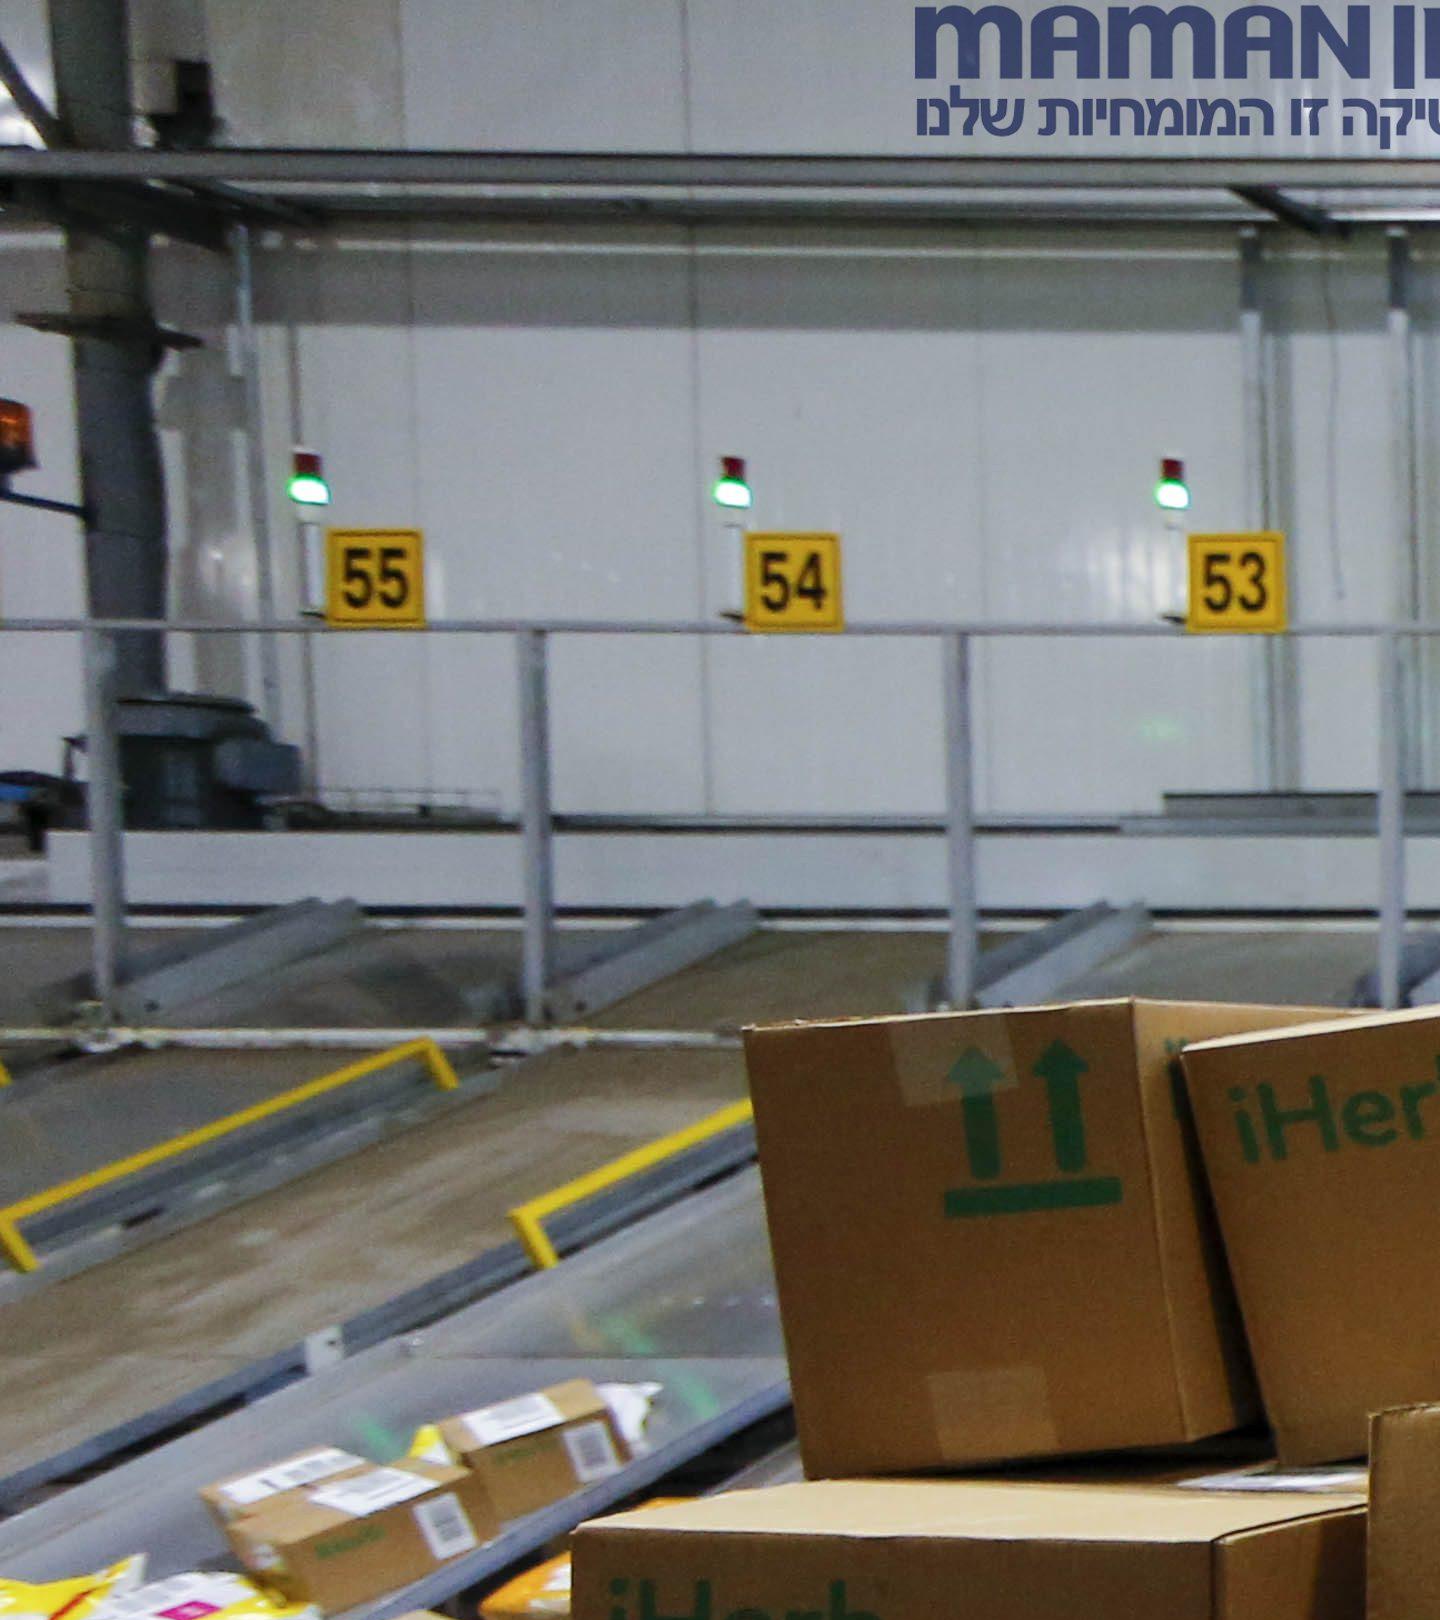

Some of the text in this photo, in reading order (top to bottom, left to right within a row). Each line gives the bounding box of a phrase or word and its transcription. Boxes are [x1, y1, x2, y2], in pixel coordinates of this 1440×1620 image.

[914, 5, 1370, 79] MAMAN
[915, 86, 1025, 137] שלנו
[1038, 97, 1274, 136] המומחיות
[1289, 98, 1329, 136] זו
[343, 547, 410, 610] 55
[760, 551, 827, 613] 54
[1203, 551, 1267, 614] 53
